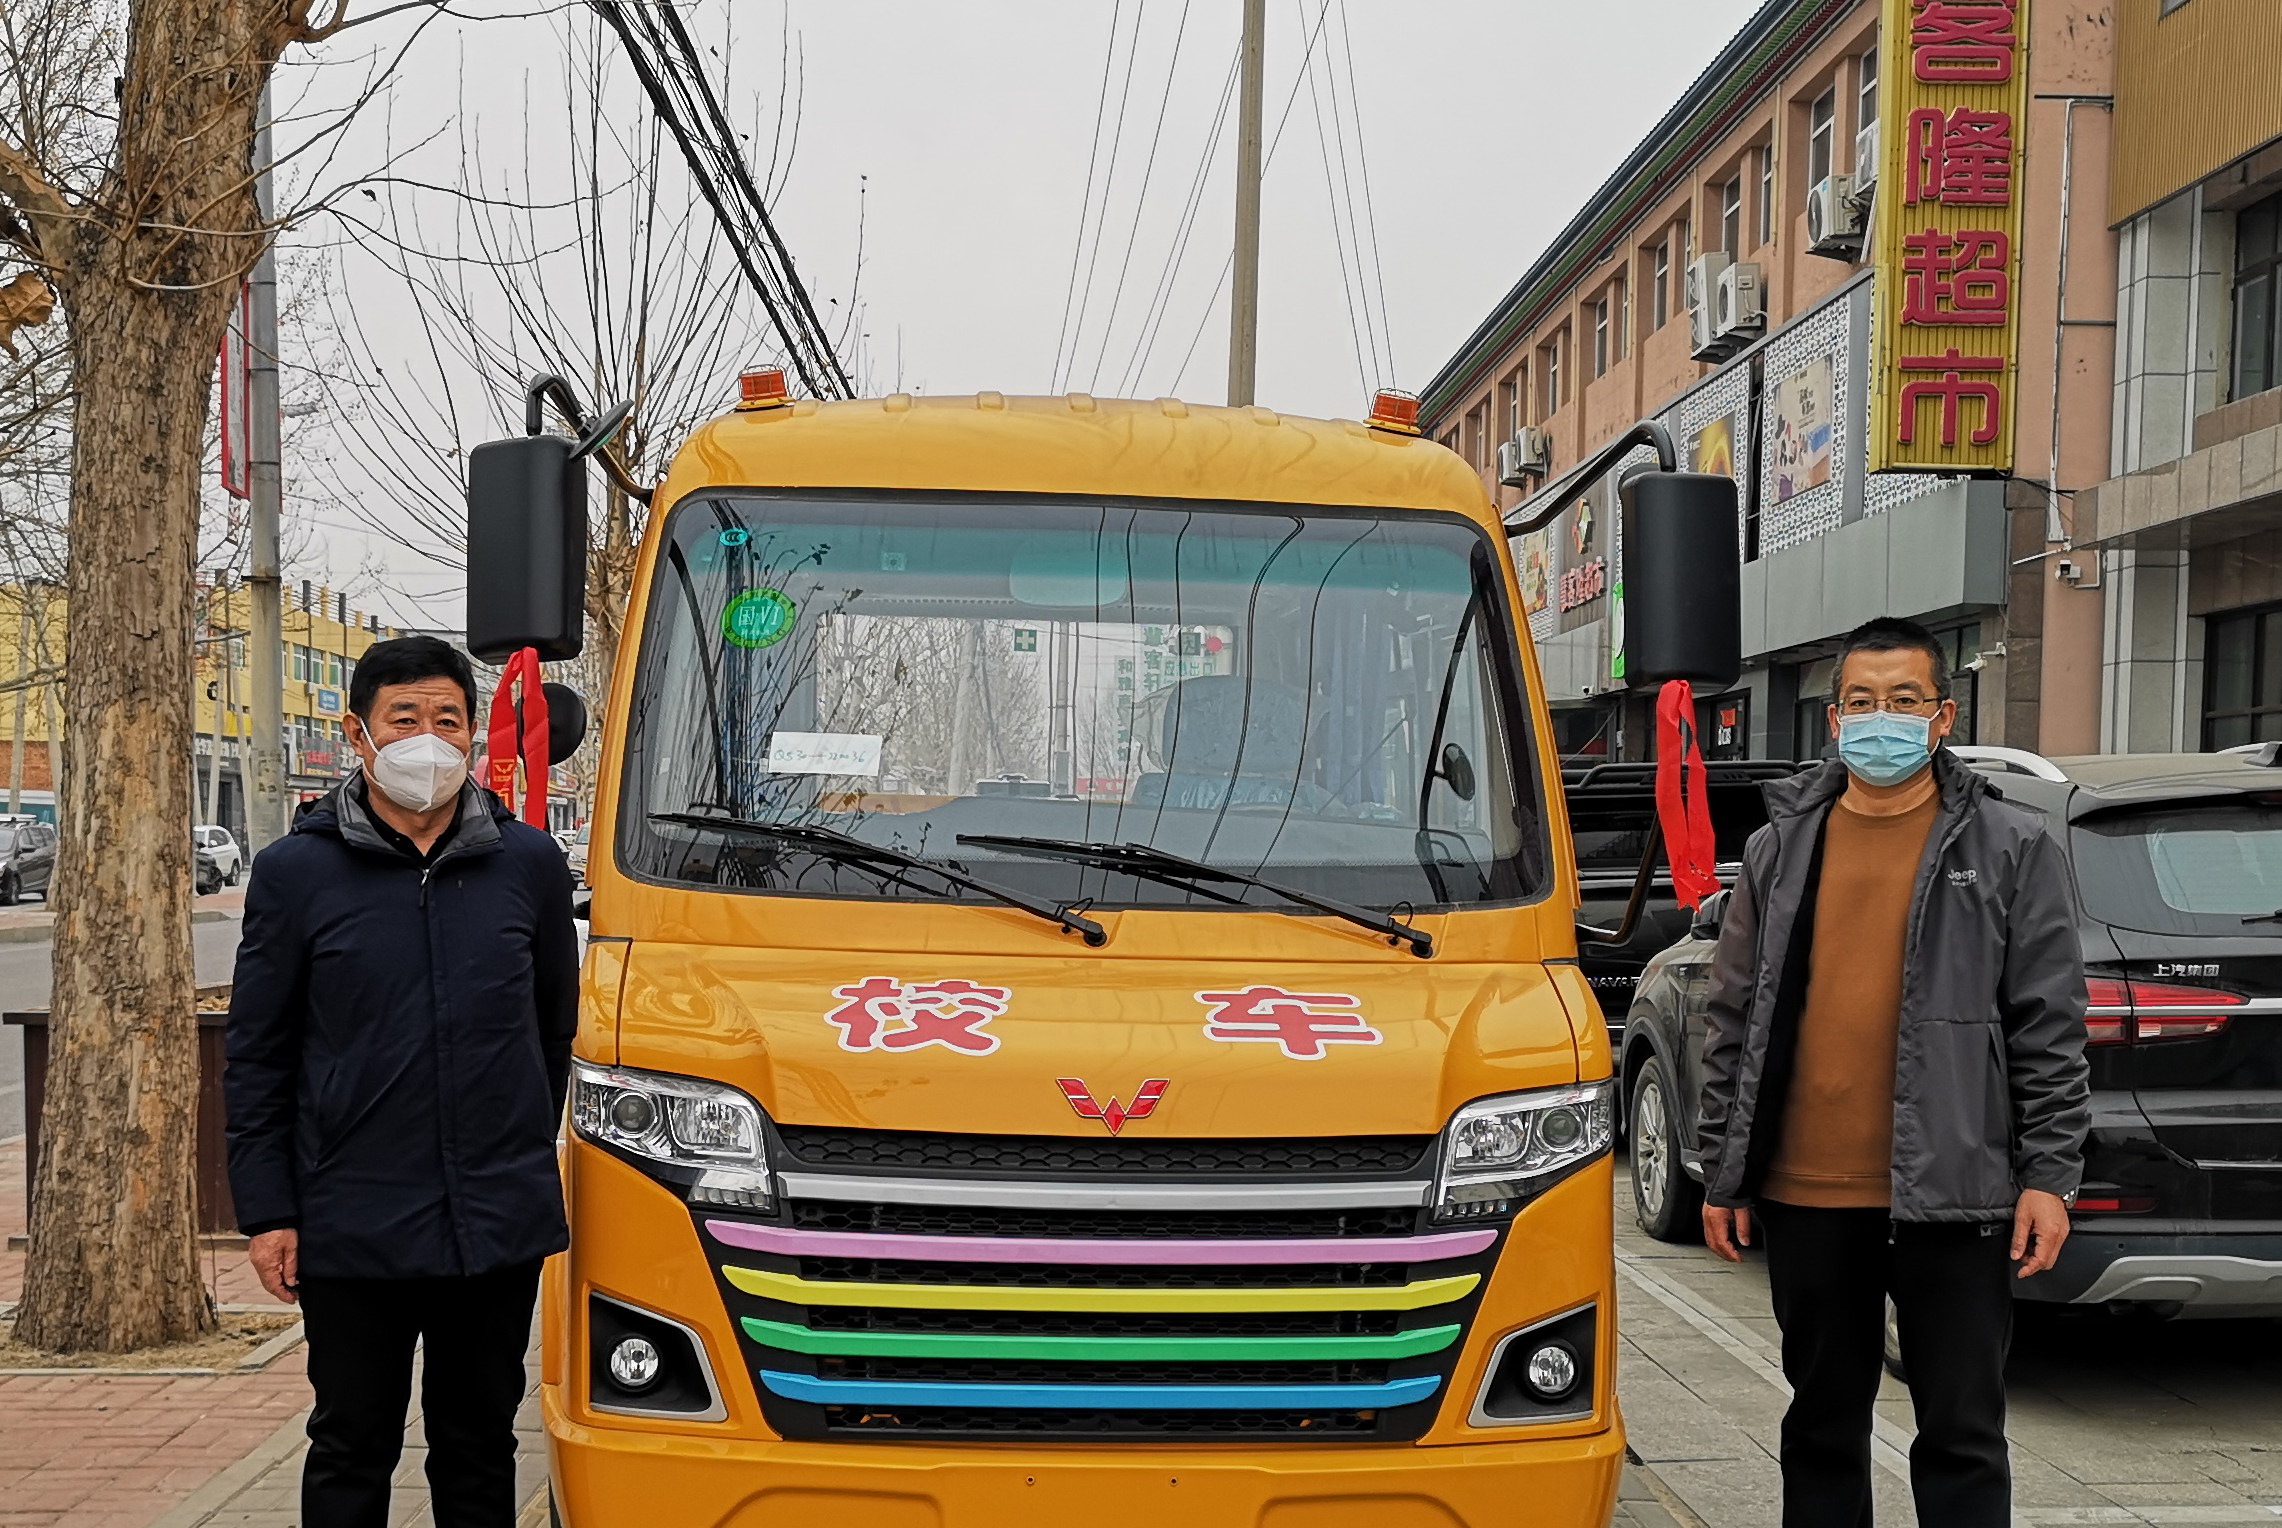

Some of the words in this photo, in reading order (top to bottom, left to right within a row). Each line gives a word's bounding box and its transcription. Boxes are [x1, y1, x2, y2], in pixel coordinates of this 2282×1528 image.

[1947, 869, 1977, 885] Jeep
[2153, 963, 2220, 977] 上汽集团
